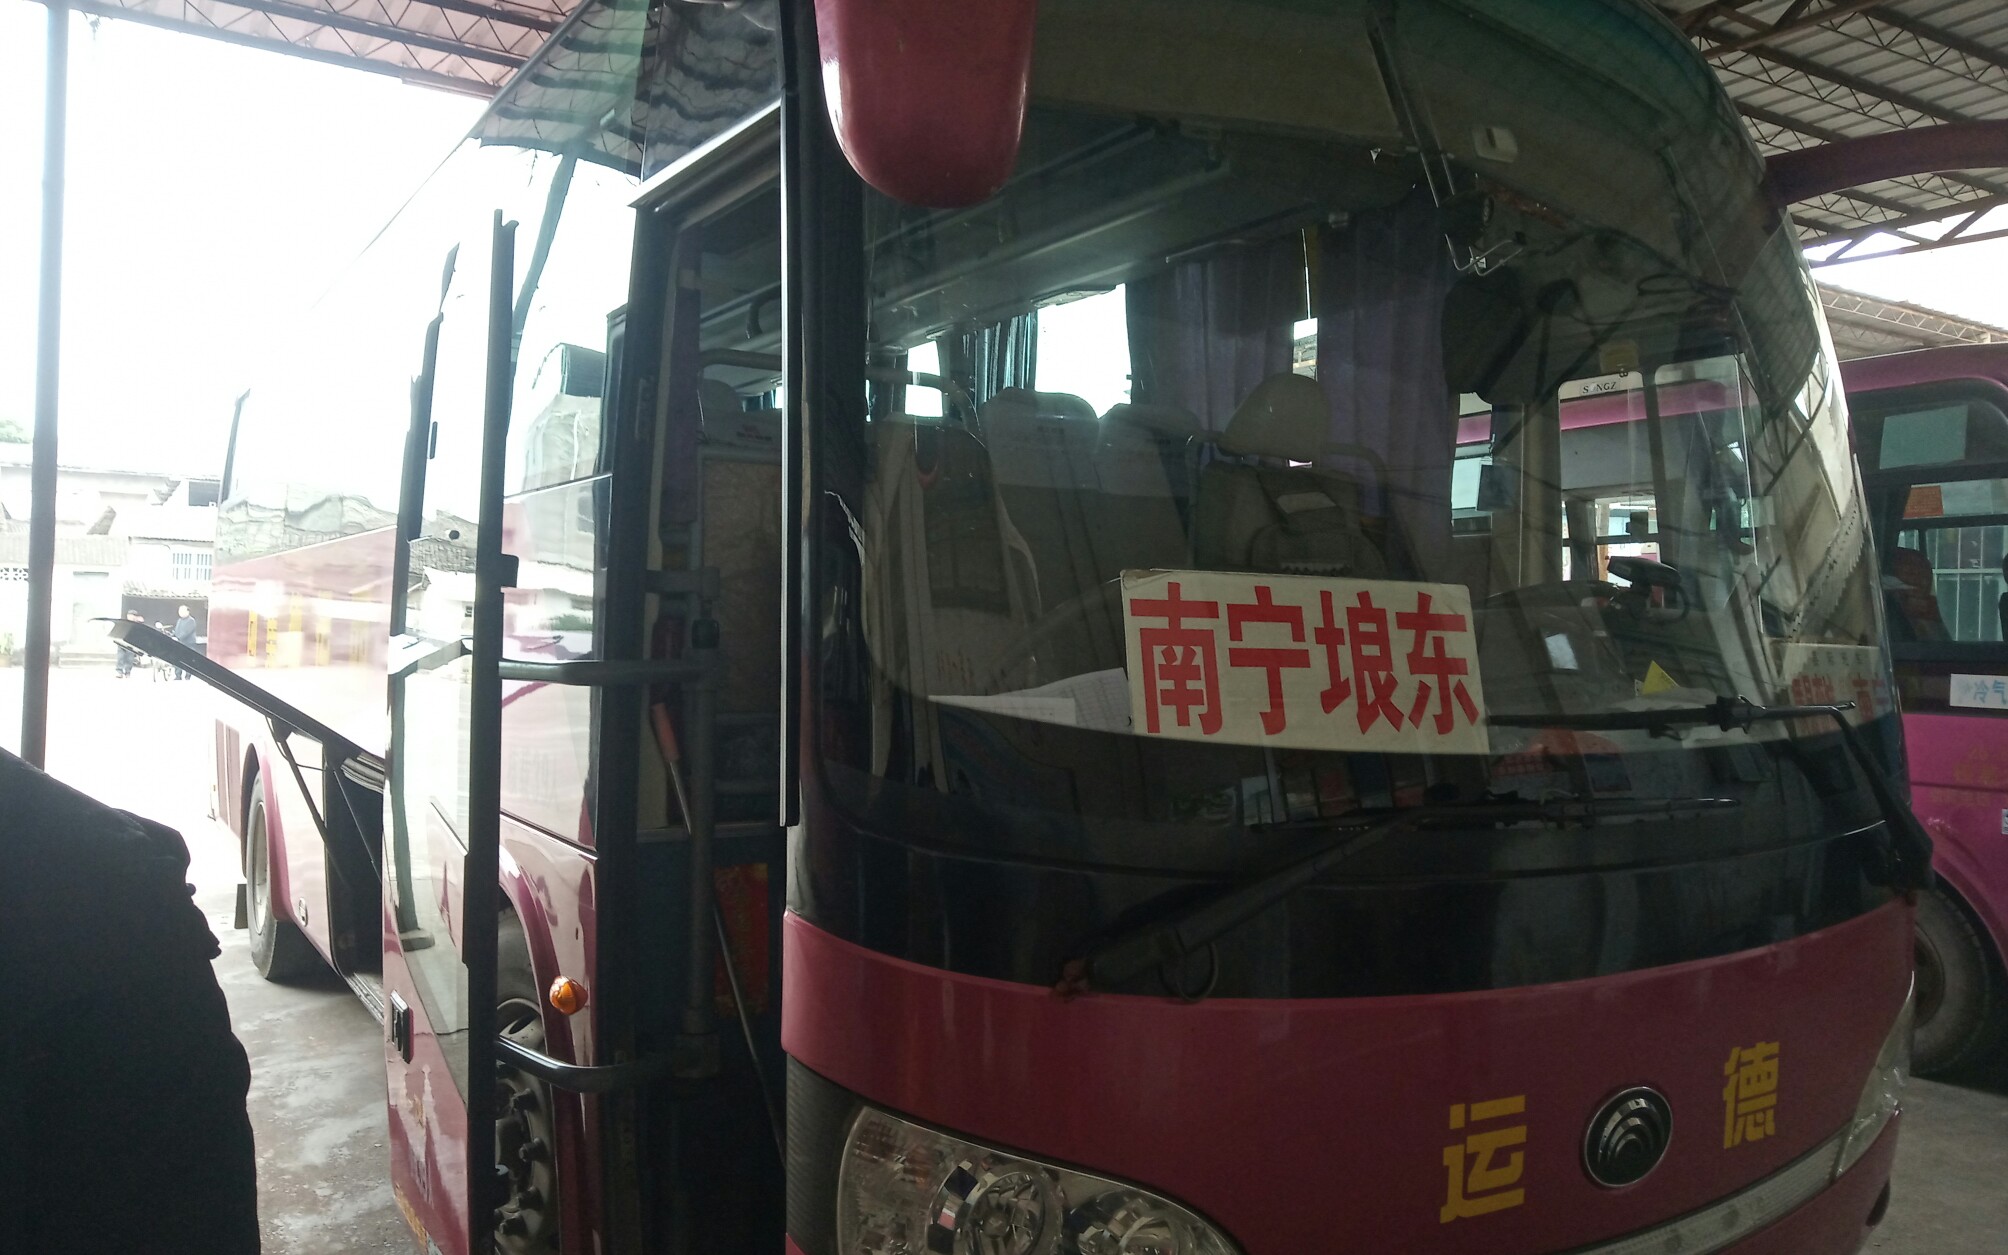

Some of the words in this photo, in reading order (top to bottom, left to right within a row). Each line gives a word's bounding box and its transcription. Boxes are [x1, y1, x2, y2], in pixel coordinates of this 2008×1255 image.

[1582, 381, 1617, 394] SNGZ
[1130, 582, 1479, 735] 南宁埌东
[1440, 1095, 1527, 1224] 运
[1723, 1041, 1780, 1150] 德
